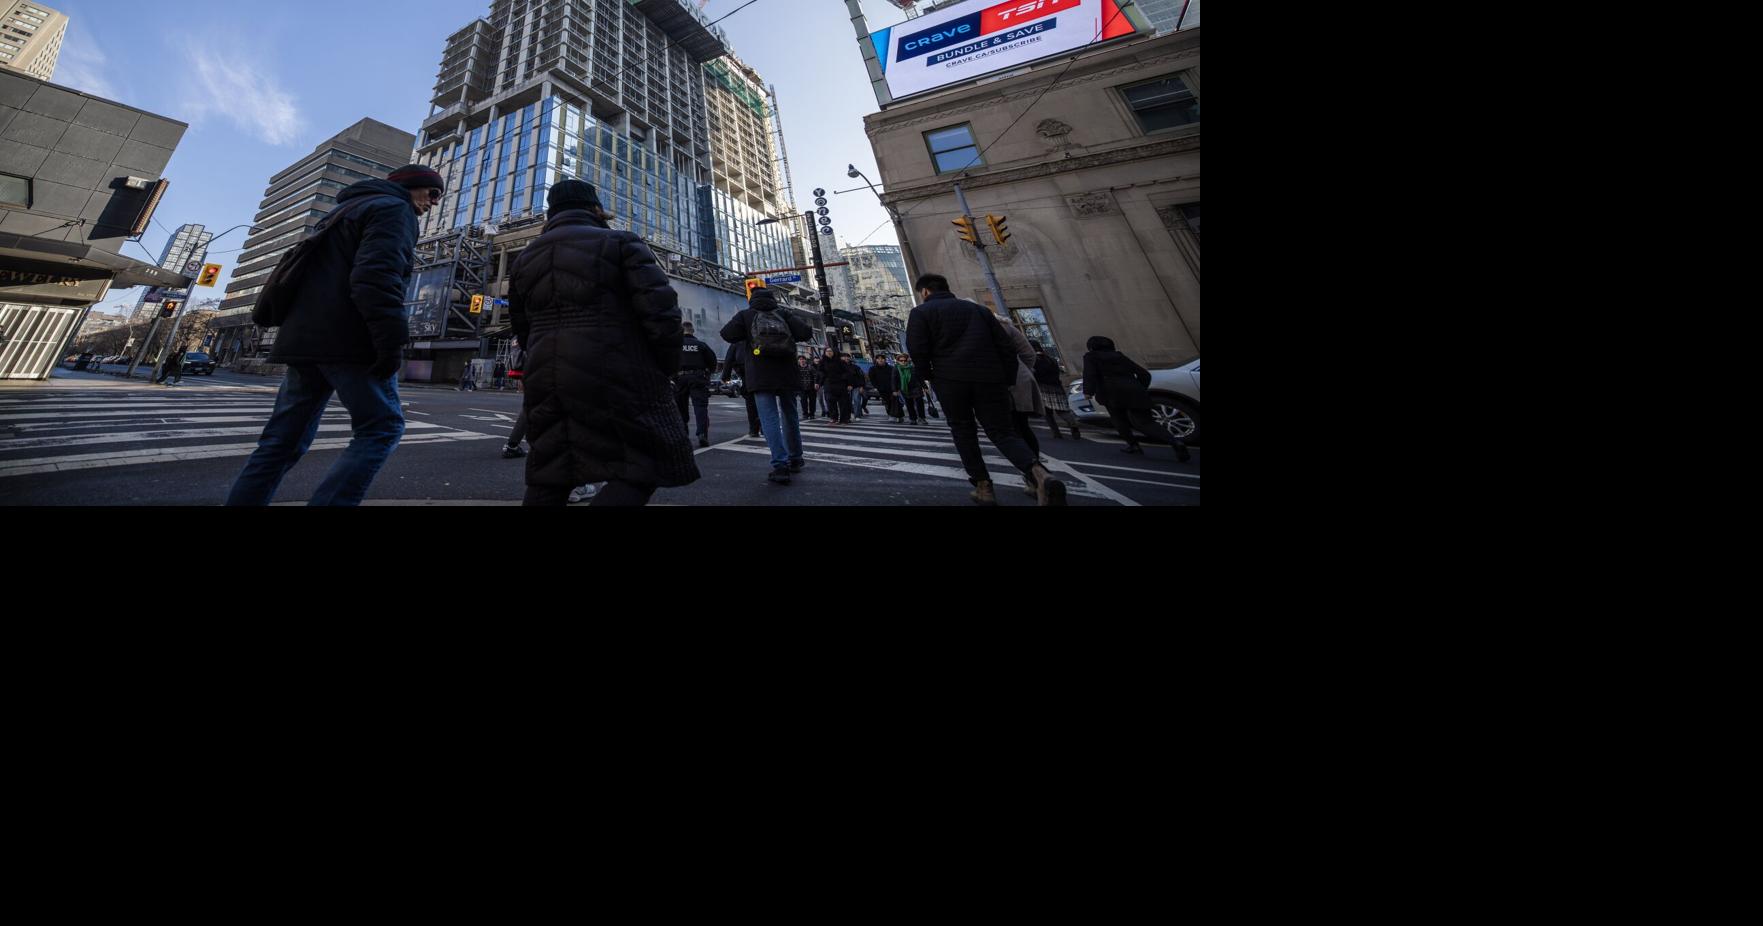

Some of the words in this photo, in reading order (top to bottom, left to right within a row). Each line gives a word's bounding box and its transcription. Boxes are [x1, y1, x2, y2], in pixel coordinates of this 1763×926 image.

[937, 41, 989, 62] BUNDLE
[993, 36, 1002, 45] &
[1007, 23, 1044, 41] SAVE
[945, 35, 1042, 68] CRAVE.CA/SUBSCRIBE
[769, 275, 793, 284] Gerrard
